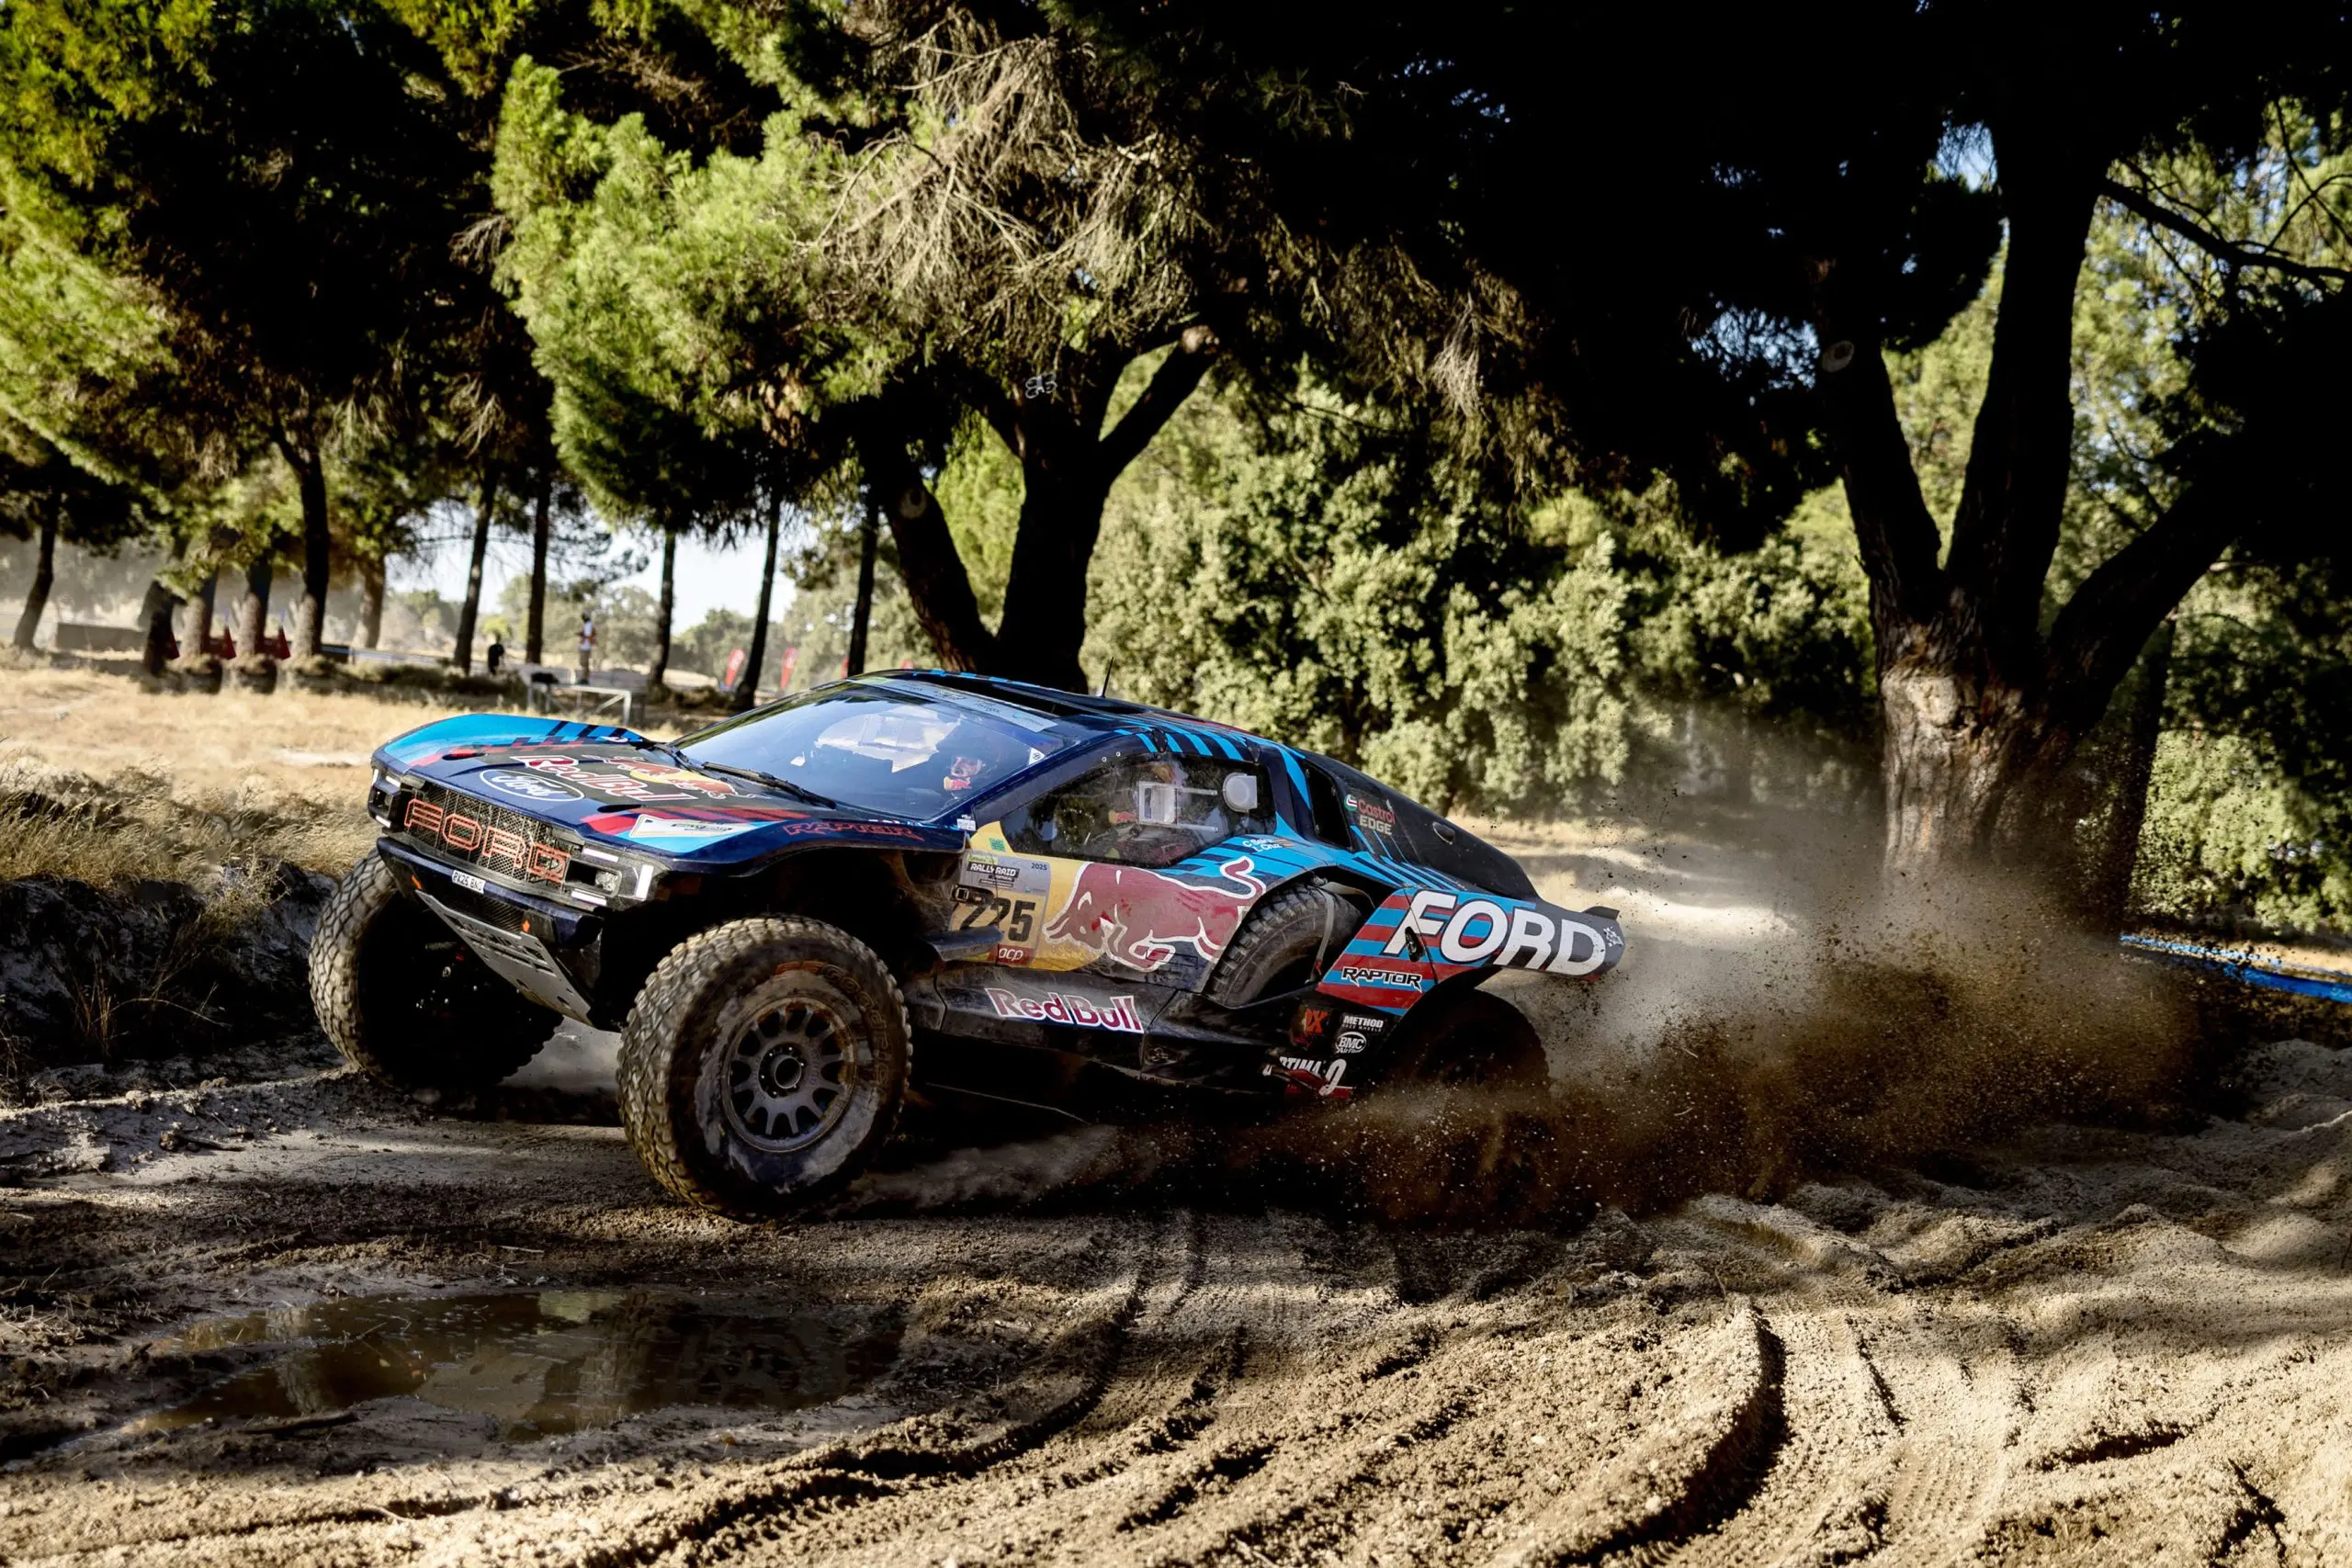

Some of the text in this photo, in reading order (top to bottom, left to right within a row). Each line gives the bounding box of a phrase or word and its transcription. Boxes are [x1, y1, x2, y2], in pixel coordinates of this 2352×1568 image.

[1357, 797, 1395, 824] Castrol
[1359, 814, 1393, 836] EDGE
[404, 798, 571, 884] FORD
[970, 863, 1017, 877] RALLY RAID
[1031, 862, 1048, 871] 2025
[1383, 890, 1607, 976] FORD
[1340, 966, 1423, 993] RAPTOR
[1342, 1015, 1385, 1029] METHOD
[1338, 1036, 1364, 1050] BMC
